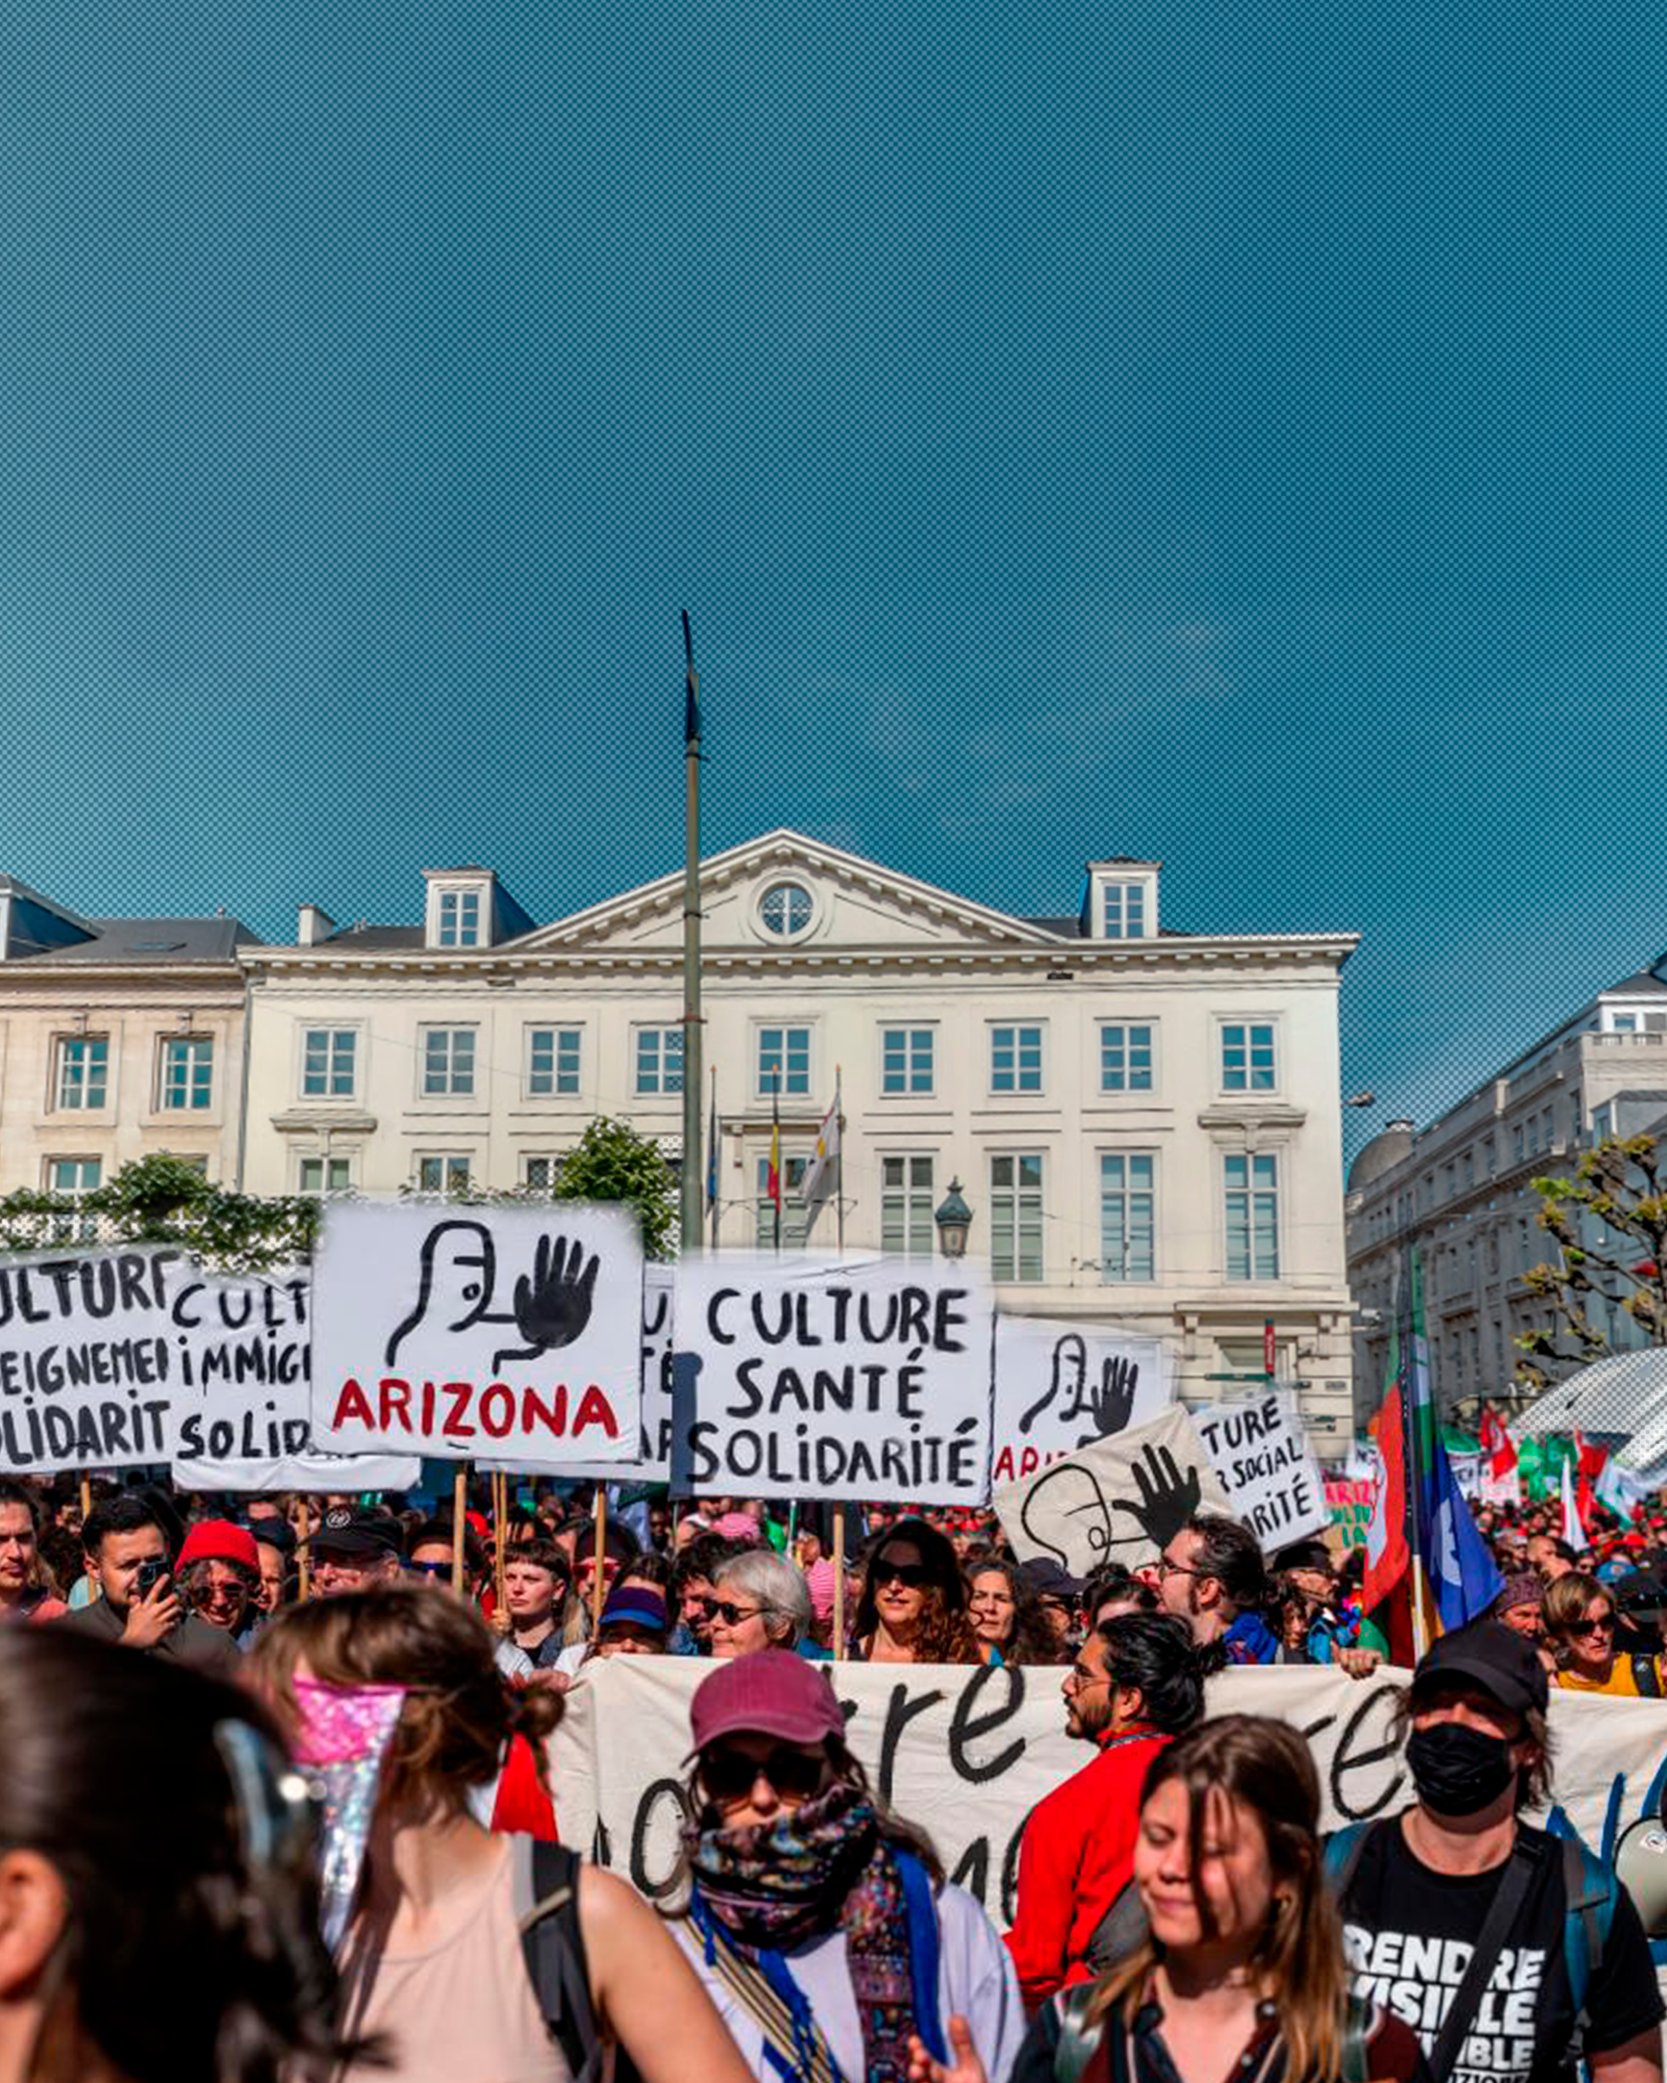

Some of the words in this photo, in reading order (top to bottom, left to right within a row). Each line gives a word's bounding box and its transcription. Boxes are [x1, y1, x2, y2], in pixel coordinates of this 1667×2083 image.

[172, 1280, 310, 1329] CULT
[707, 1287, 968, 1352] CULTURE
[332, 1378, 618, 1438] ARIZONA
[727, 1347, 926, 1419] SANTÉ
[0, 1389, 171, 1465] LiDARiT
[1201, 1397, 1281, 1455] TURE
